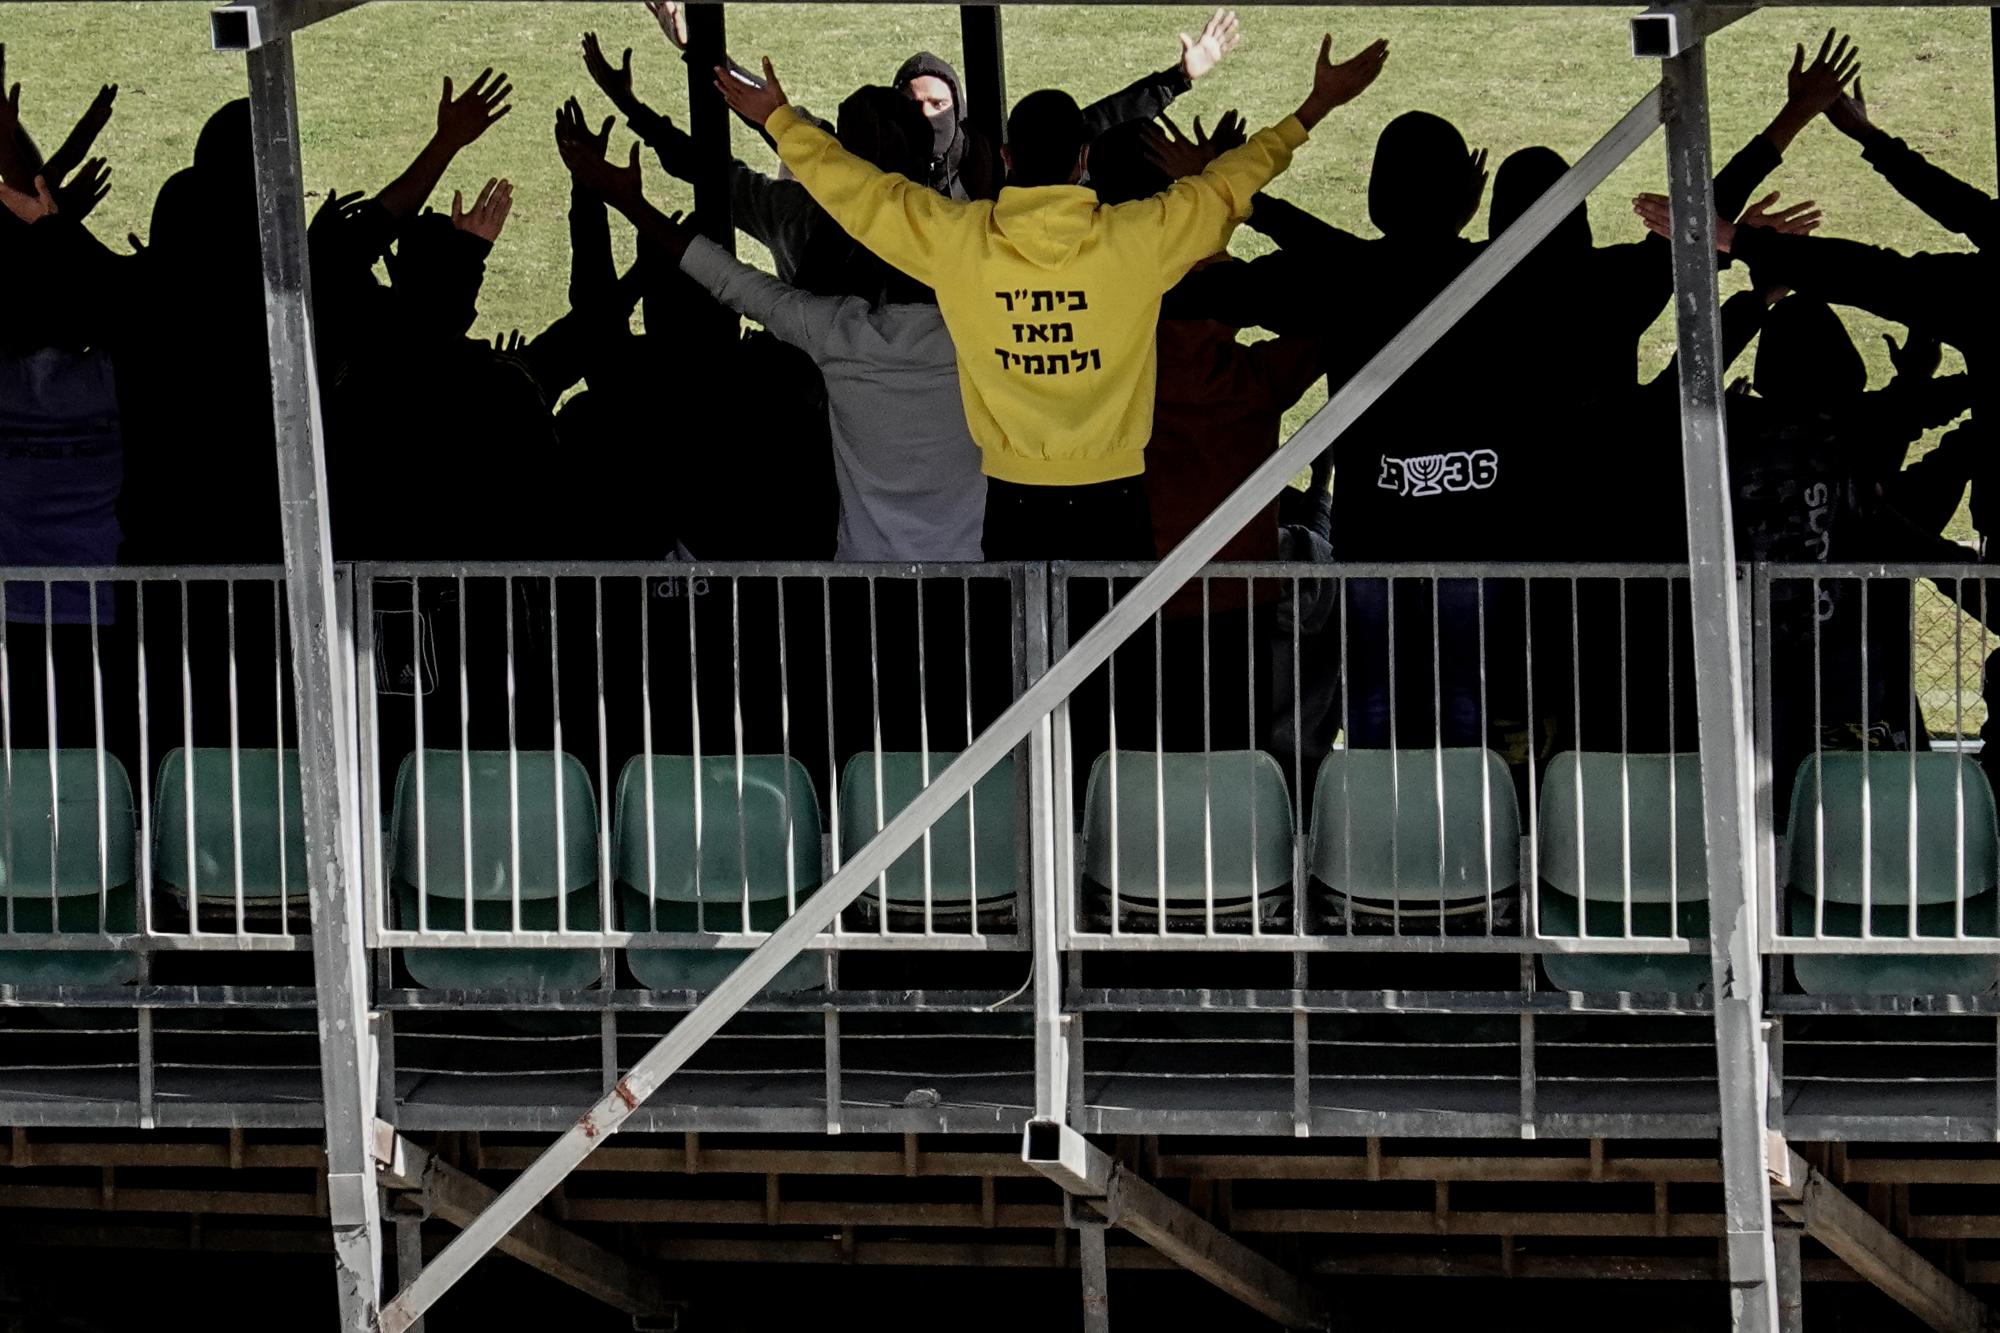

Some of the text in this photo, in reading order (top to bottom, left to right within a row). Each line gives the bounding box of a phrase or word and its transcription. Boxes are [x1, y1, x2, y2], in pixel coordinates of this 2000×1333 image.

[1012, 322, 1074, 343] מאז
[994, 348, 1102, 375] ולתמיד
[1443, 448, 1498, 492] 36
